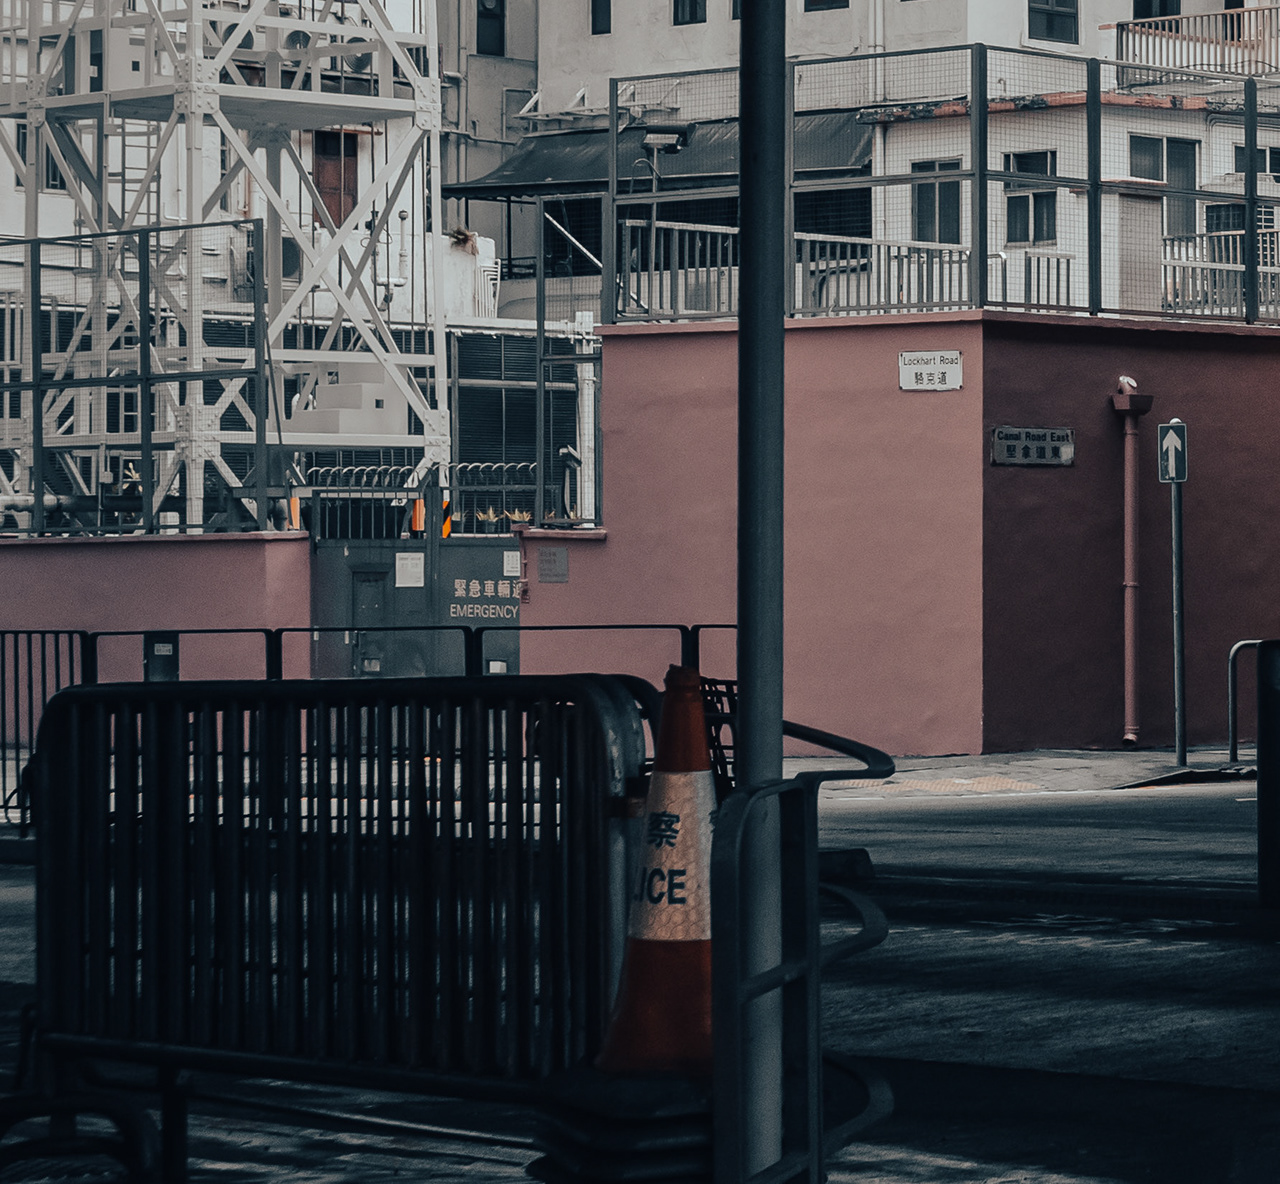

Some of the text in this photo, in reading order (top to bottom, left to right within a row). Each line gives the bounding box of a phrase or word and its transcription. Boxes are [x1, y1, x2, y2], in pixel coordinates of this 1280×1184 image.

[903, 355, 959, 366] Lockhart Road
[914, 371, 947, 385] 駱克道
[997, 430, 1070, 442] Canal Road East
[1006, 444, 1061, 459] 堅拿道東
[450, 604, 519, 618] EMERGENCY
[647, 810, 681, 849] 察
[633, 866, 687, 905] ICE
